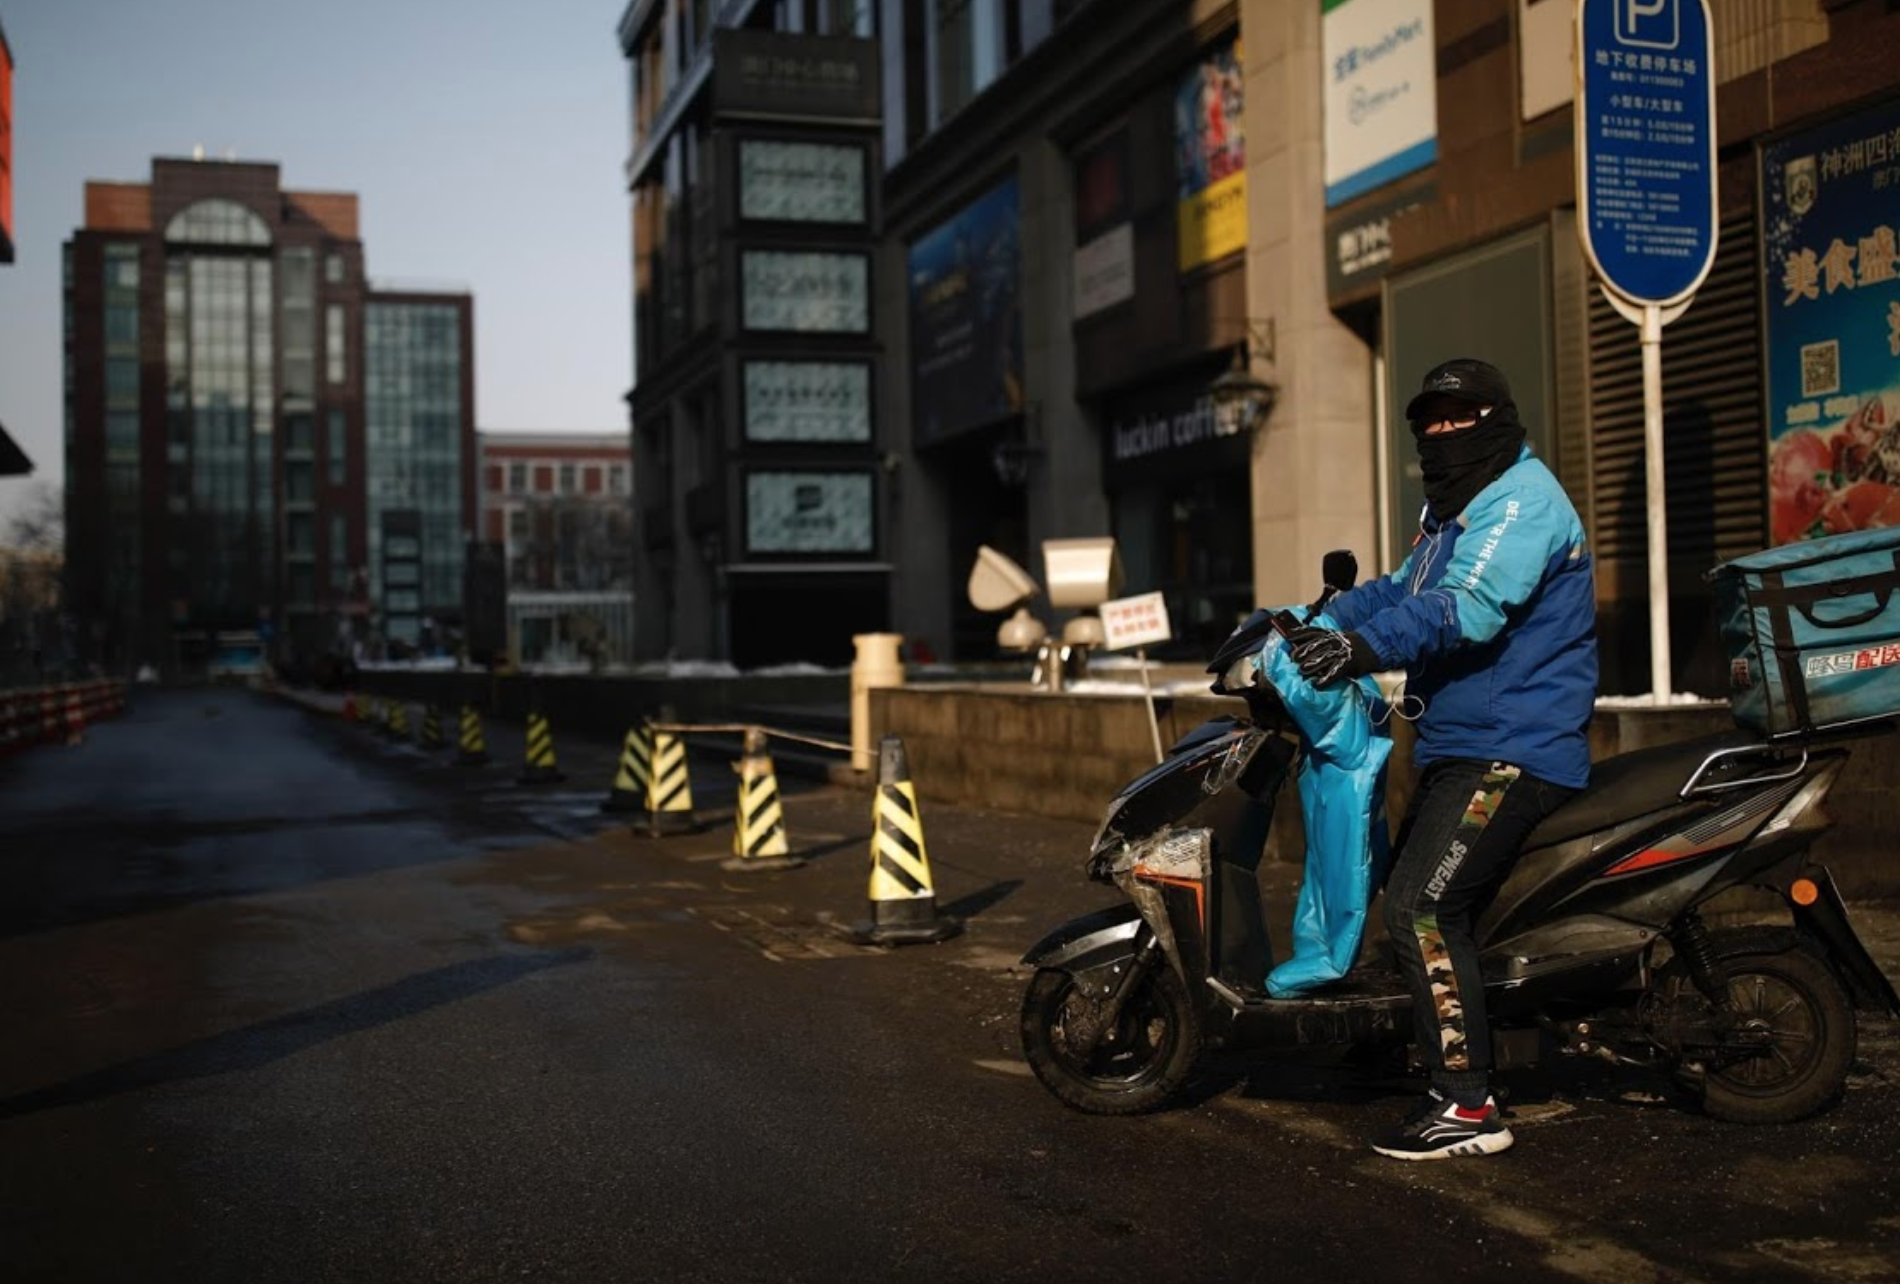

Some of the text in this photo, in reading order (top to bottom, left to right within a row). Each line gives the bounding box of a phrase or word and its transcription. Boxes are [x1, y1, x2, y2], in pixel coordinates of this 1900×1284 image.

[1595, 50, 1696, 75] 地下收费停车场
[1782, 225, 1900, 306] 美食盛
[1478, 538, 1499, 560] THE
